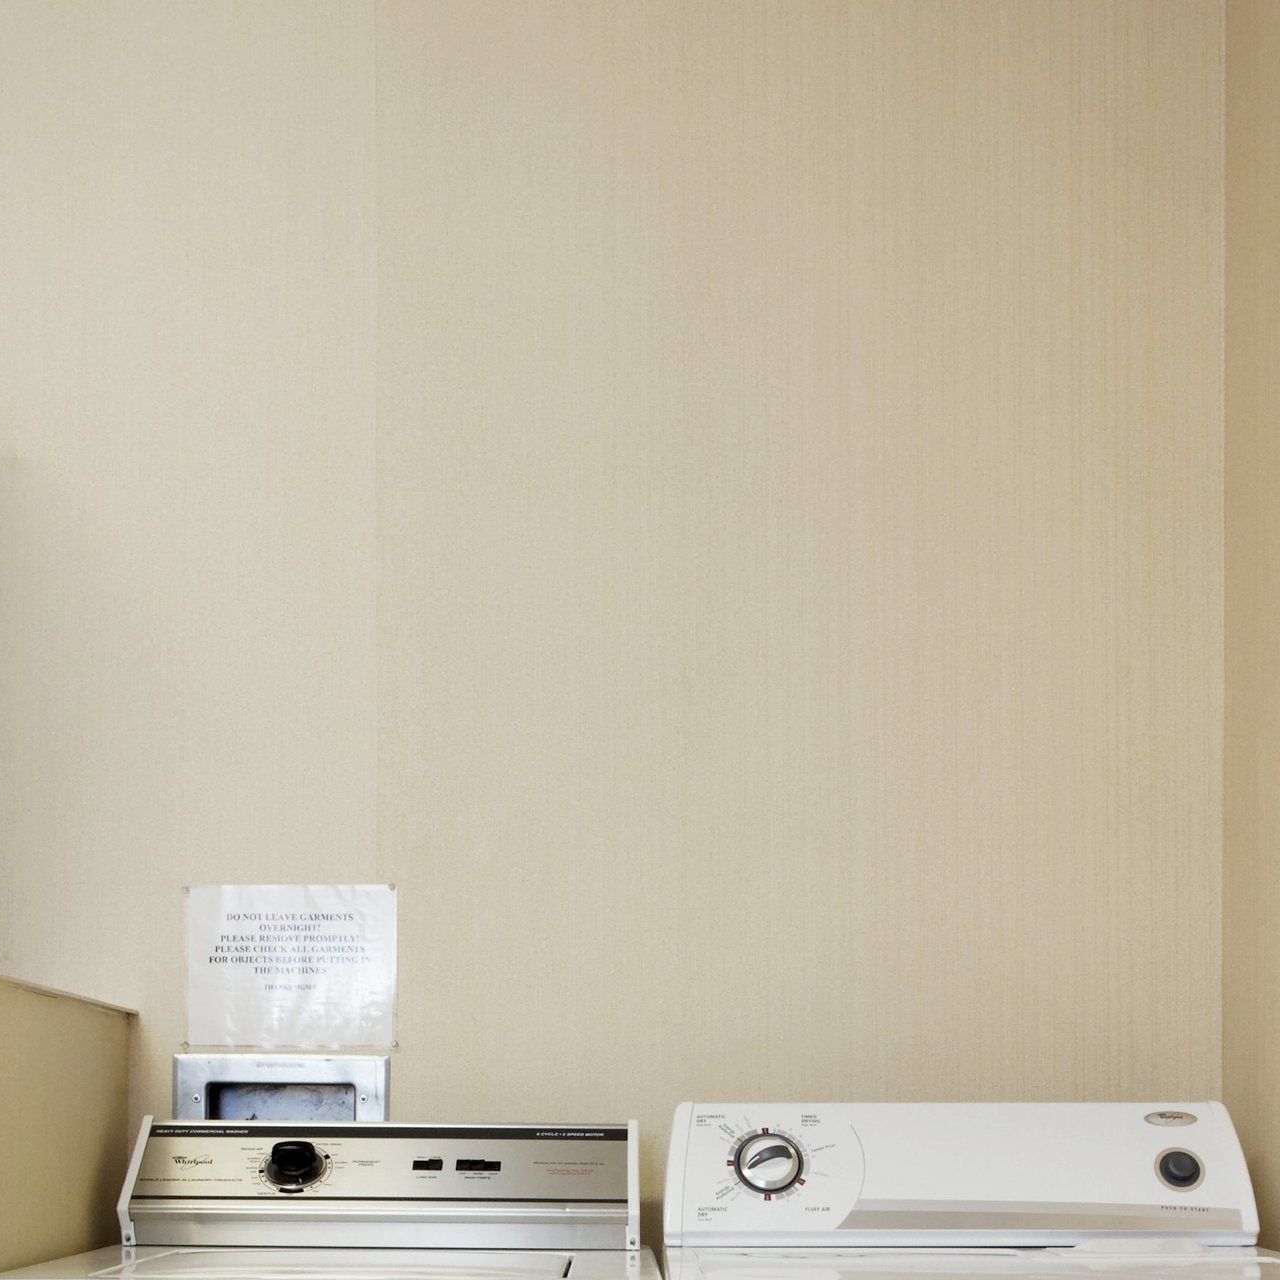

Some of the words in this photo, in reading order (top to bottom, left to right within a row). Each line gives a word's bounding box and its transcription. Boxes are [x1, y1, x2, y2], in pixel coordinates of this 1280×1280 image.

[226, 913, 240, 921] DO
[243, 913, 262, 921] NOT
[265, 913, 297, 921] LEAVE
[300, 913, 354, 921] GARMENTS
[220, 934, 255, 942] PLEASE
[259, 934, 300, 942] REMOVE
[215, 945, 251, 953] PLEASE
[253, 945, 287, 953] CHECK
[290, 945, 308, 953] ALL
[311, 945, 366, 953] GARMENTS
[209, 956, 228, 964] FOR
[230, 956, 273, 964] OBJECTS
[276, 956, 314, 964] BEFORE
[316, 956, 358, 964] PUTTING
[253, 967, 272, 975] THE
[274, 967, 327, 975] MACHINES
[172, 1156, 213, 1166] Whirlpool
